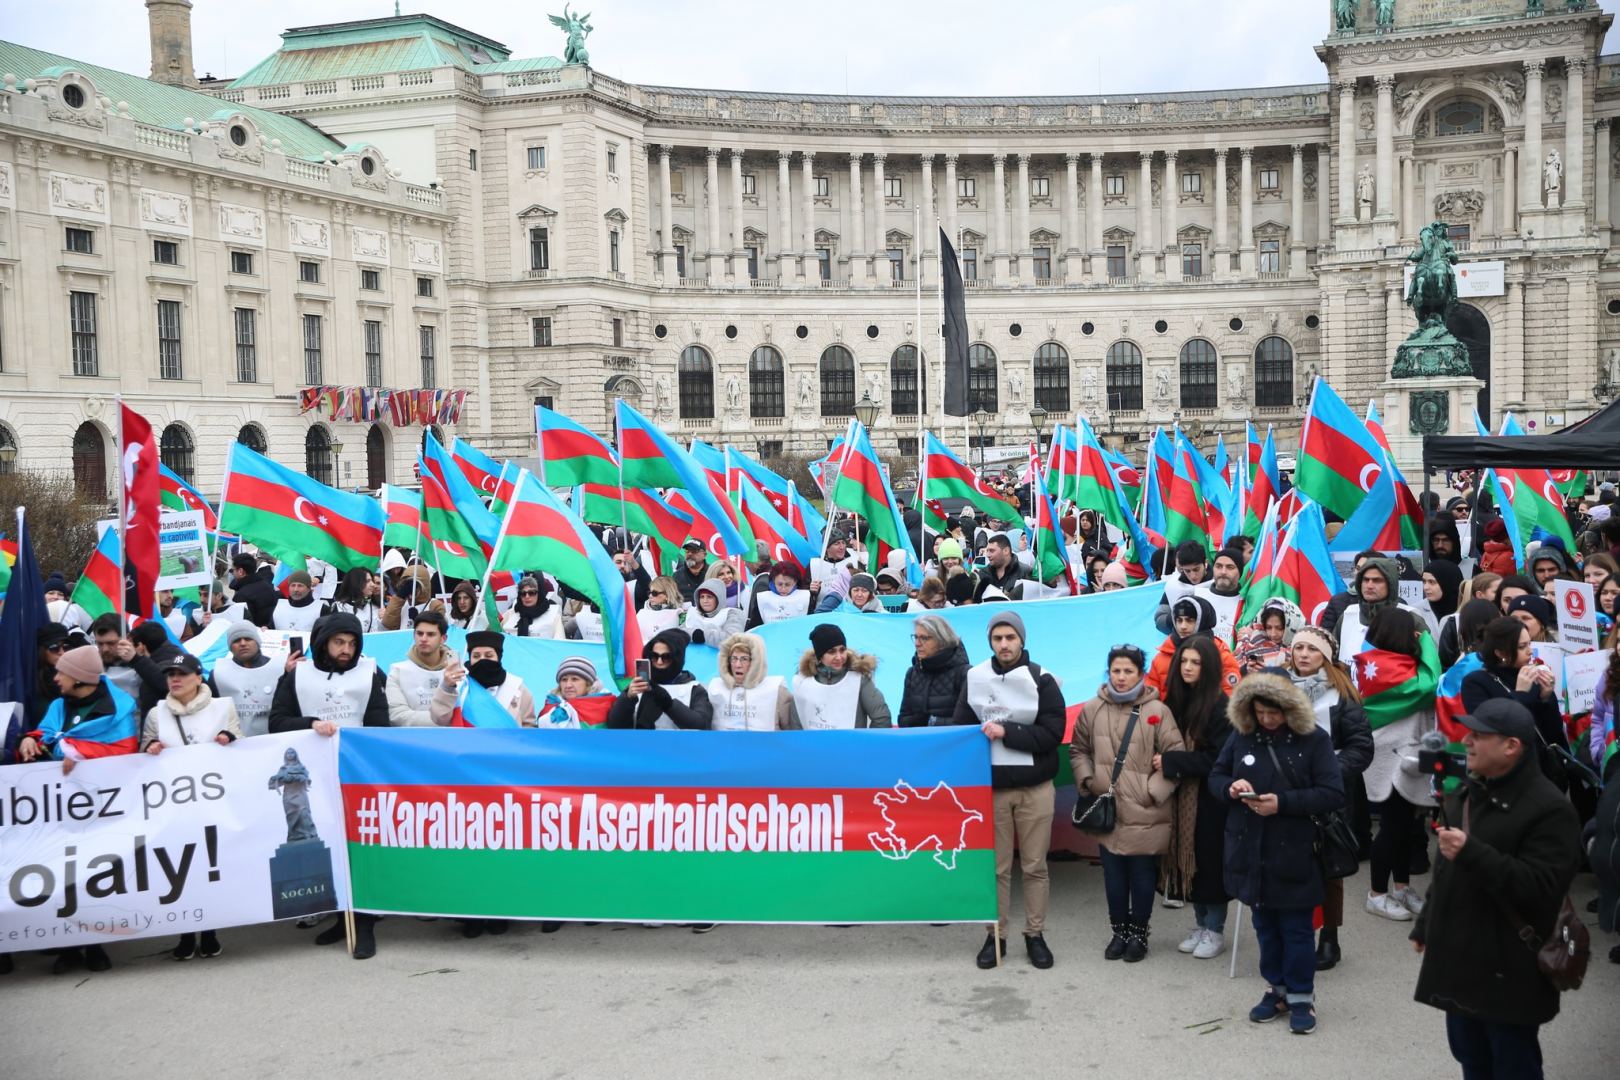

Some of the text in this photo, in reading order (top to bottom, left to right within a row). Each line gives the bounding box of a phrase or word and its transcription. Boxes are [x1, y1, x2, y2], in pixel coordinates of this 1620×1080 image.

[0, 771, 226, 827] bliez pas
[357, 791, 843, 853] #Karabach ist Aserbaidschan!
